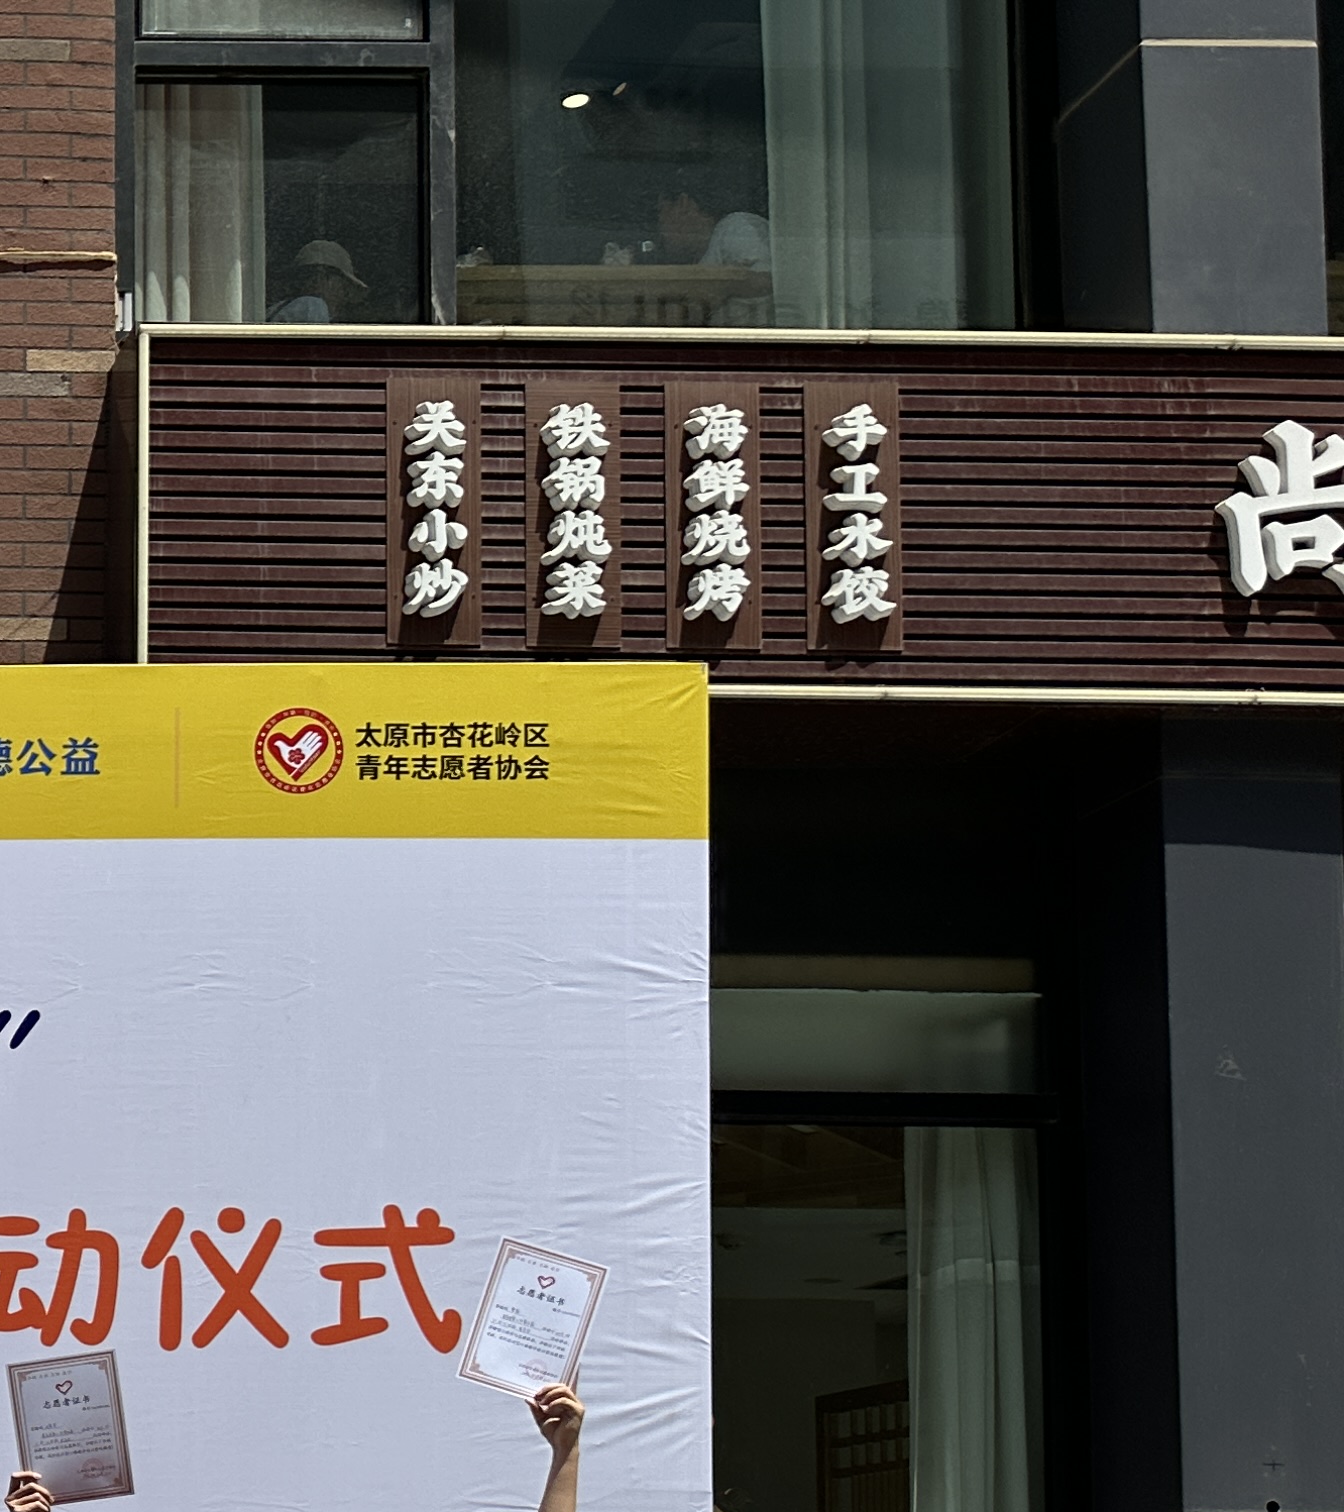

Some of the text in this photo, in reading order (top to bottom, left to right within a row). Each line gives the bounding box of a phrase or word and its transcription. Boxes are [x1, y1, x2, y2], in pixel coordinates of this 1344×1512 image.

[404, 400, 468, 618] 关东小炒
[540, 401, 613, 620] 铁锅炖菜
[683, 402, 750, 621] 海鲜烧烤
[821, 402, 896, 624] 手工水饺
[355, 722, 551, 749] 太原市杏花岭区
[355, 754, 551, 781] 青年志愿者协会
